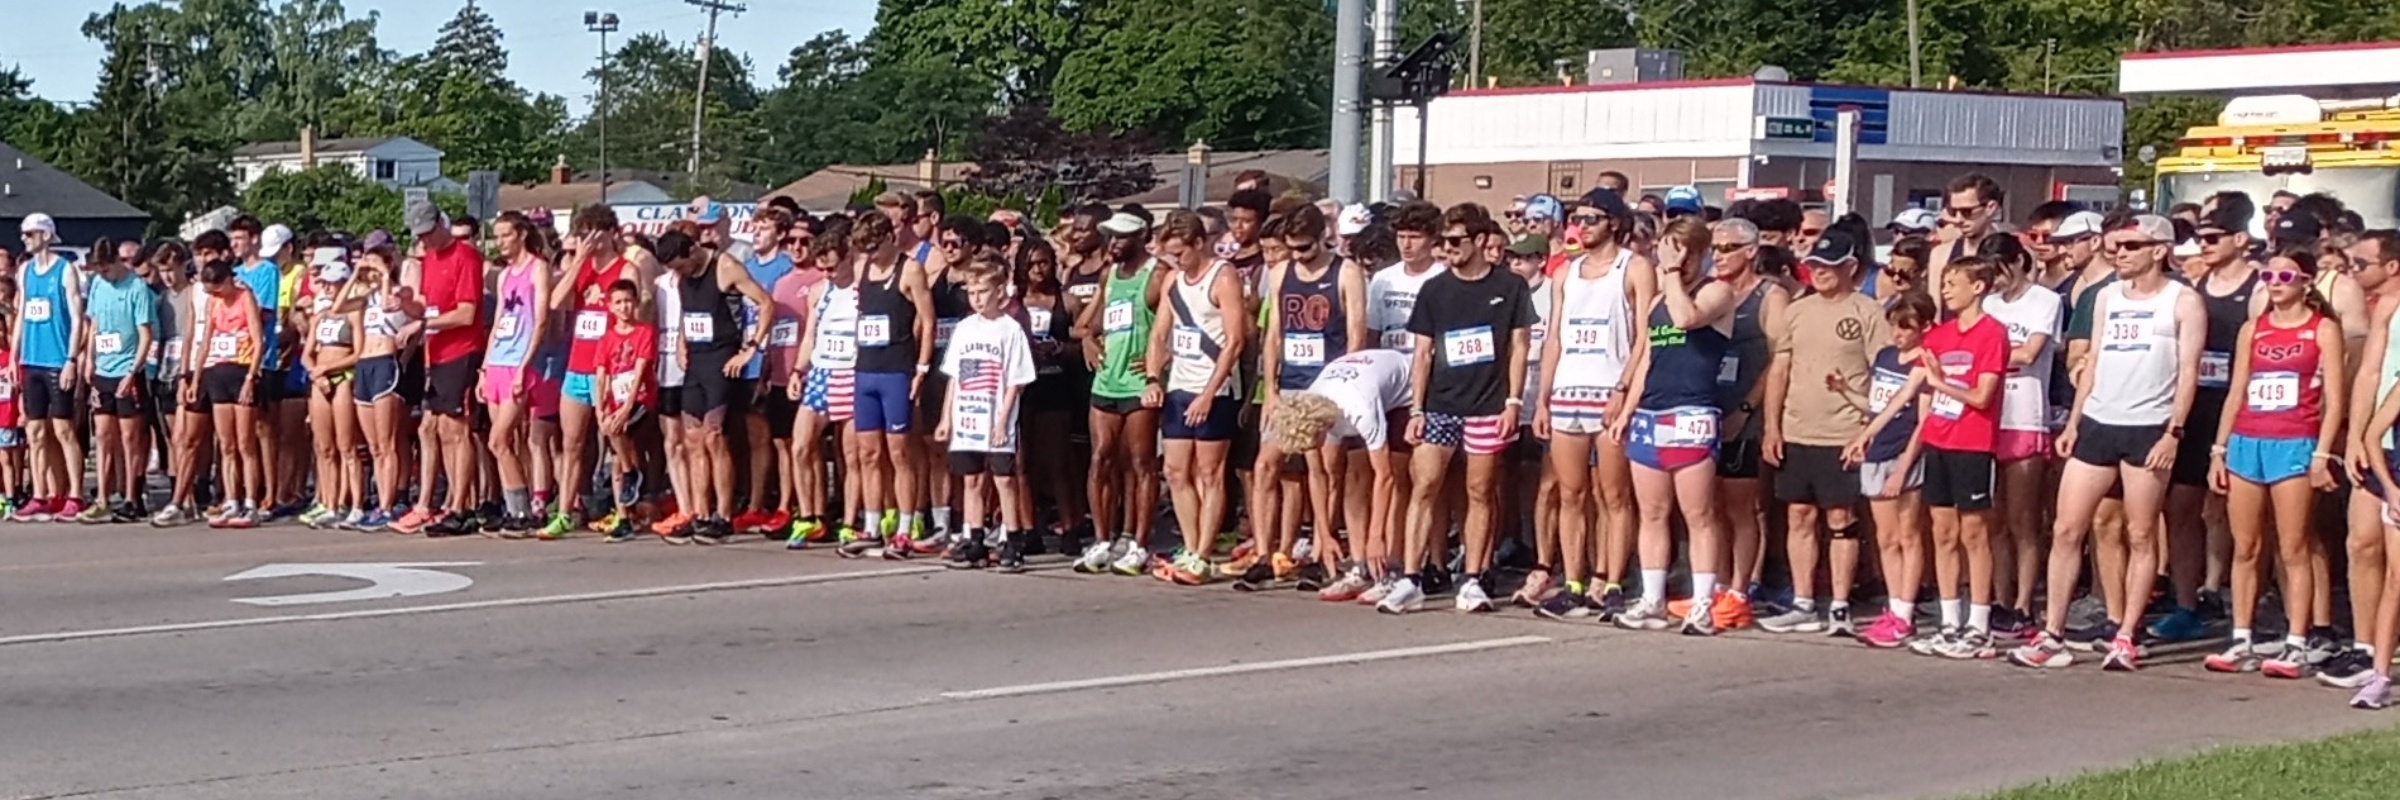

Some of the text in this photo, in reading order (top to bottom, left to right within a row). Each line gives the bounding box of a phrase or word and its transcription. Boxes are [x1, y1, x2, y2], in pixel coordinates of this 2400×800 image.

[1573, 329, 1596, 345] 349
[2112, 324, 2138, 340] 338
[1292, 343, 1314, 358] 239
[1456, 338, 1482, 356] 268
[2256, 343, 2301, 361] USA
[2257, 384, 2283, 401] 419
